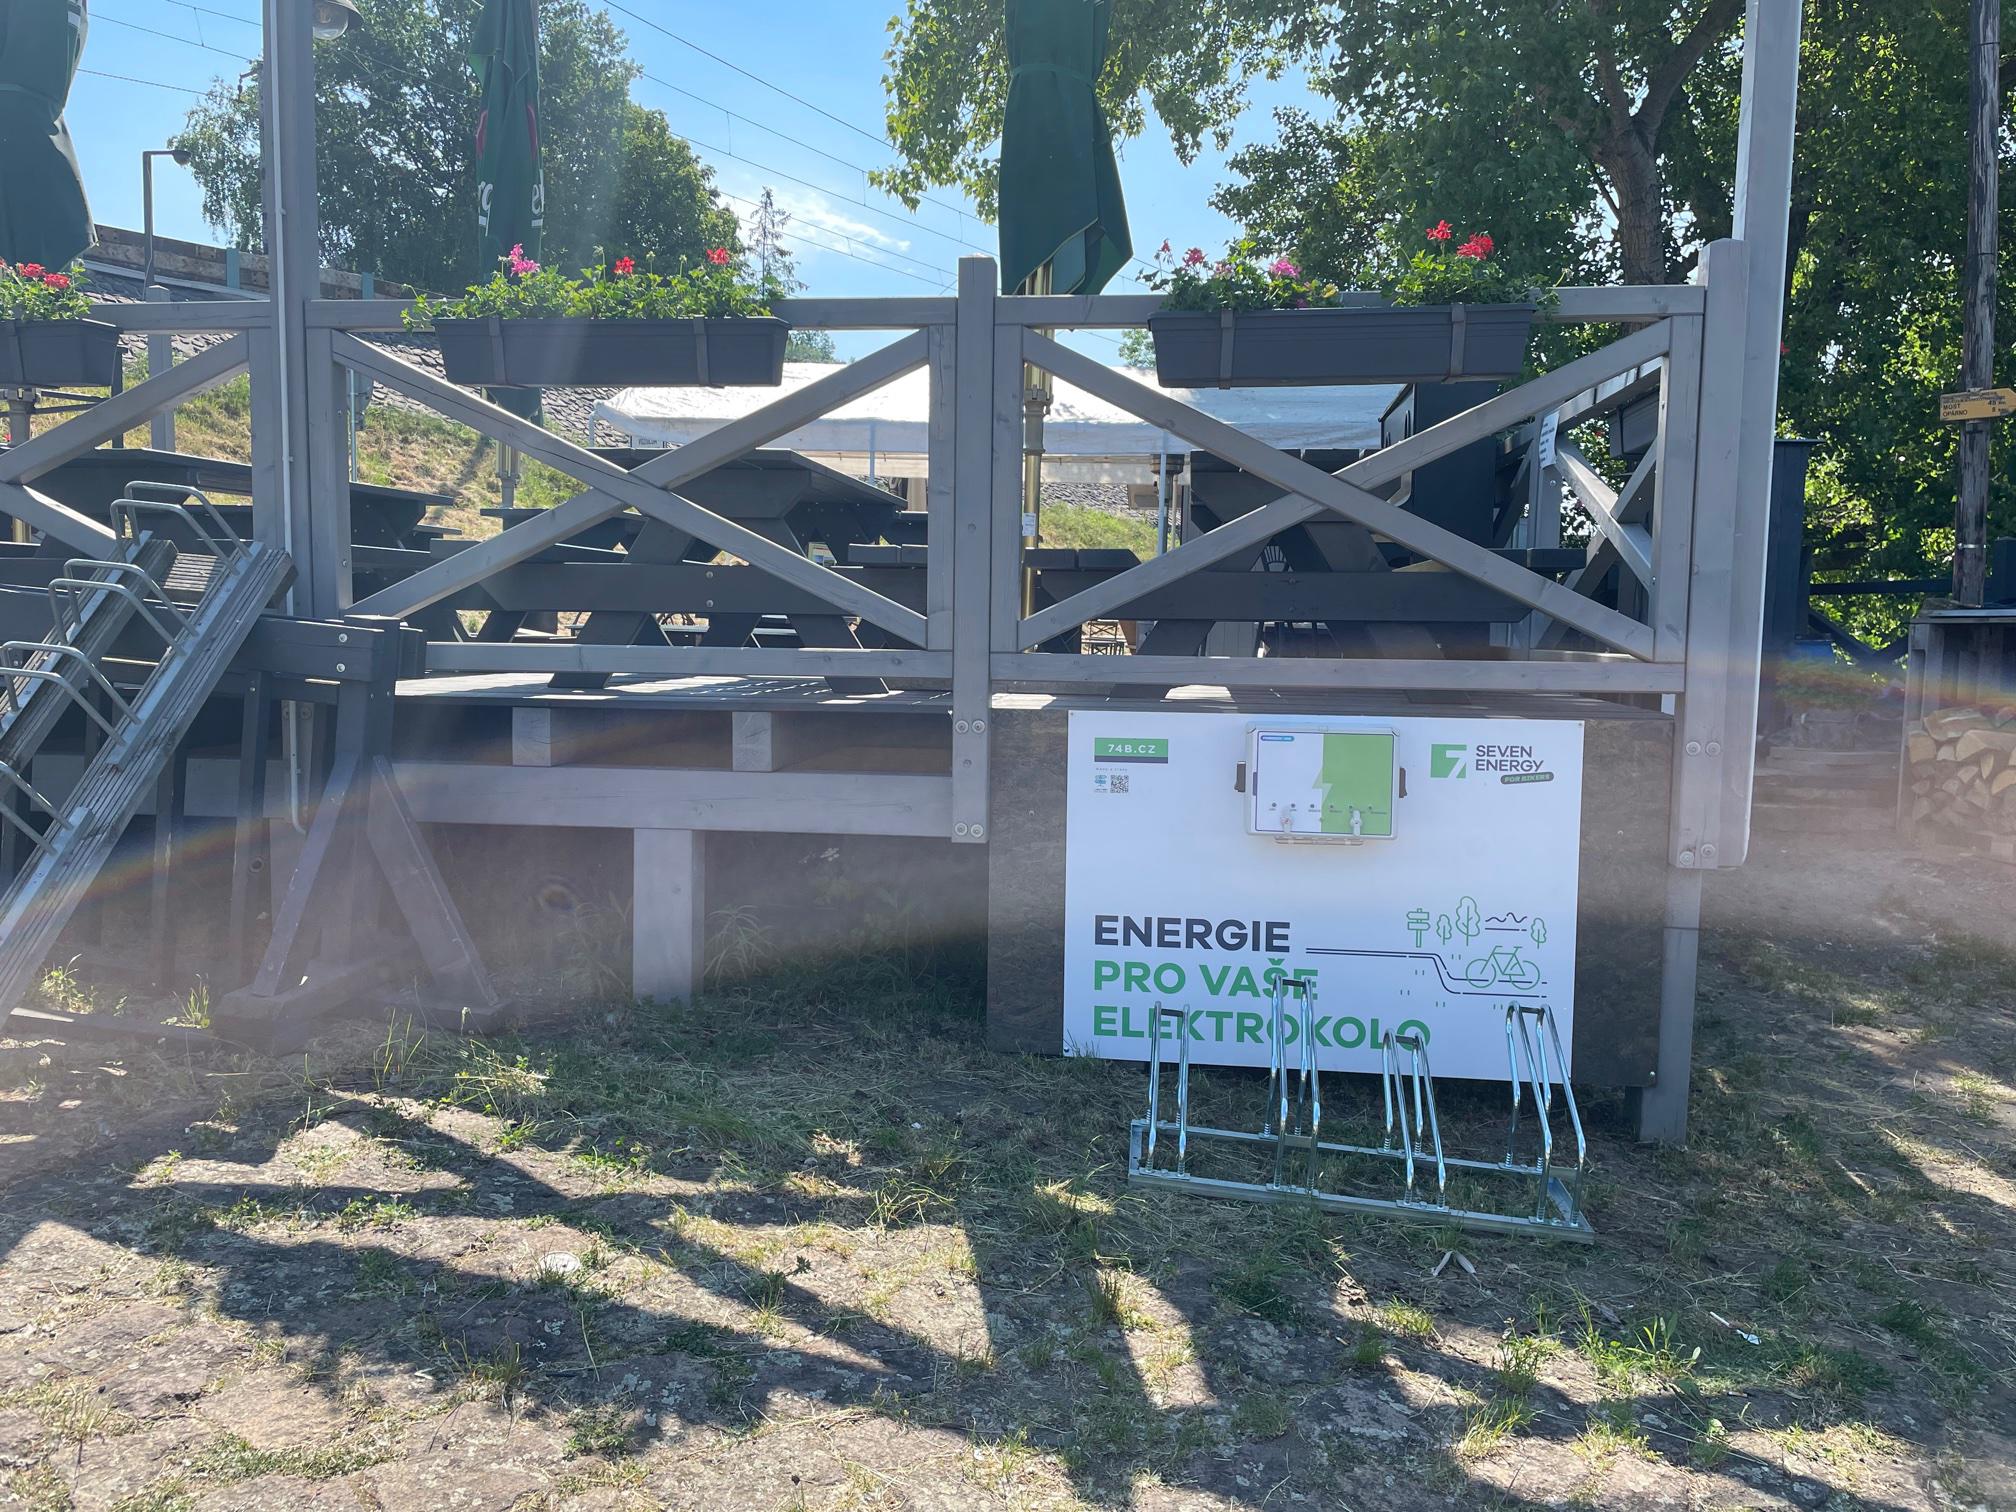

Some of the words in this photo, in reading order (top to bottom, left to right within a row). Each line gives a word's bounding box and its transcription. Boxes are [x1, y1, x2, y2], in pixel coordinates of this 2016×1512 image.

[1108, 744, 1156, 754] 74B.CZ
[1475, 759, 1544, 772] ENERGY
[1504, 775, 1520, 783] FOR
[1521, 772, 1551, 781] BIKERS
[1093, 914, 1291, 952] ENERGIE
[1093, 960, 1187, 995] PRO
[1199, 958, 1319, 1001] VAŠE
